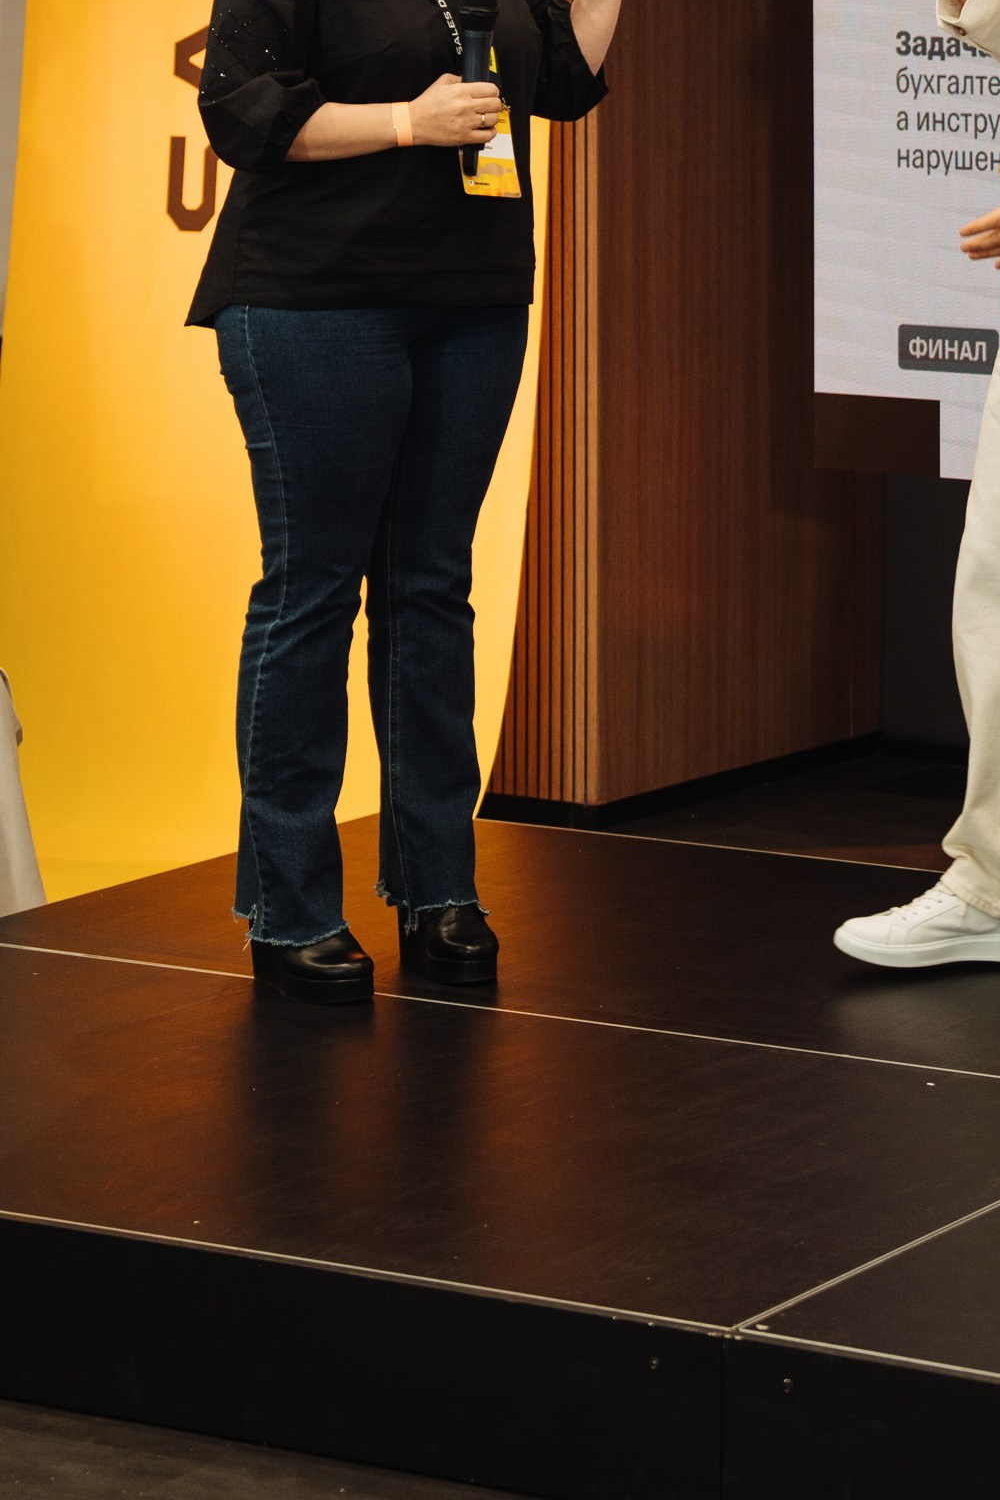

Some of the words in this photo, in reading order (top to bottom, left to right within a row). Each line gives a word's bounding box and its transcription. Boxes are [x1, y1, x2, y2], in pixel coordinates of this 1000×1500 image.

[443, 11, 463, 55] SALES
[896, 110, 909, 131] а
[908, 335, 988, 362] ФИНАЛ
